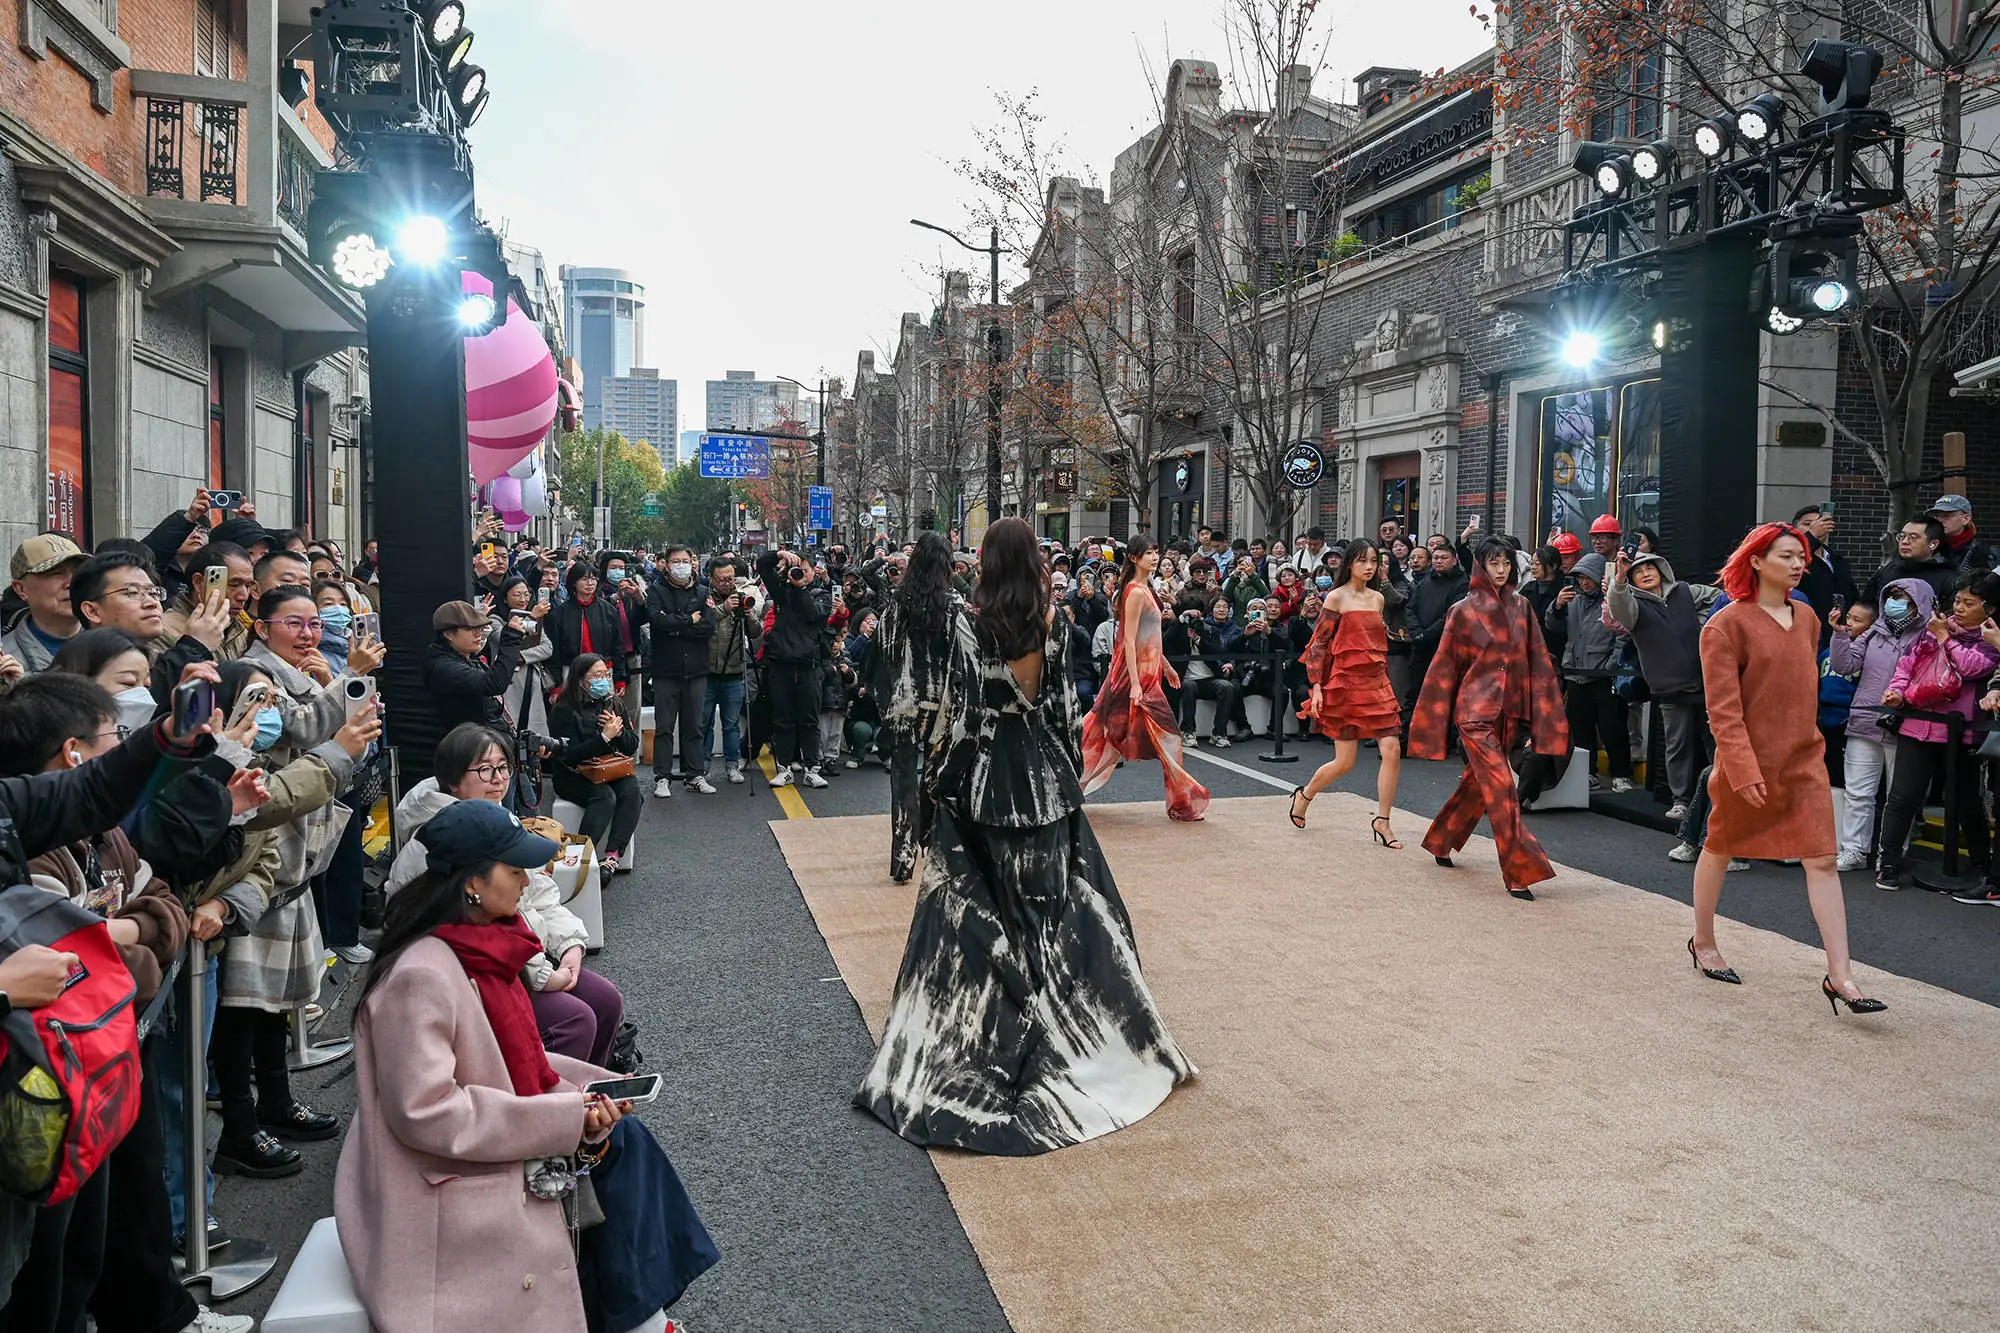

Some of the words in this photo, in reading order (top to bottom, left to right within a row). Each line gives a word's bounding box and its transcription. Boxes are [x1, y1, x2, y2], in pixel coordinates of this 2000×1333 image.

[1378, 151, 1413, 177] GOOSE
[1415, 126, 1456, 159] ISLAND
[718, 439, 752, 447] 延安中路
[703, 452, 730, 460] 石门一路
